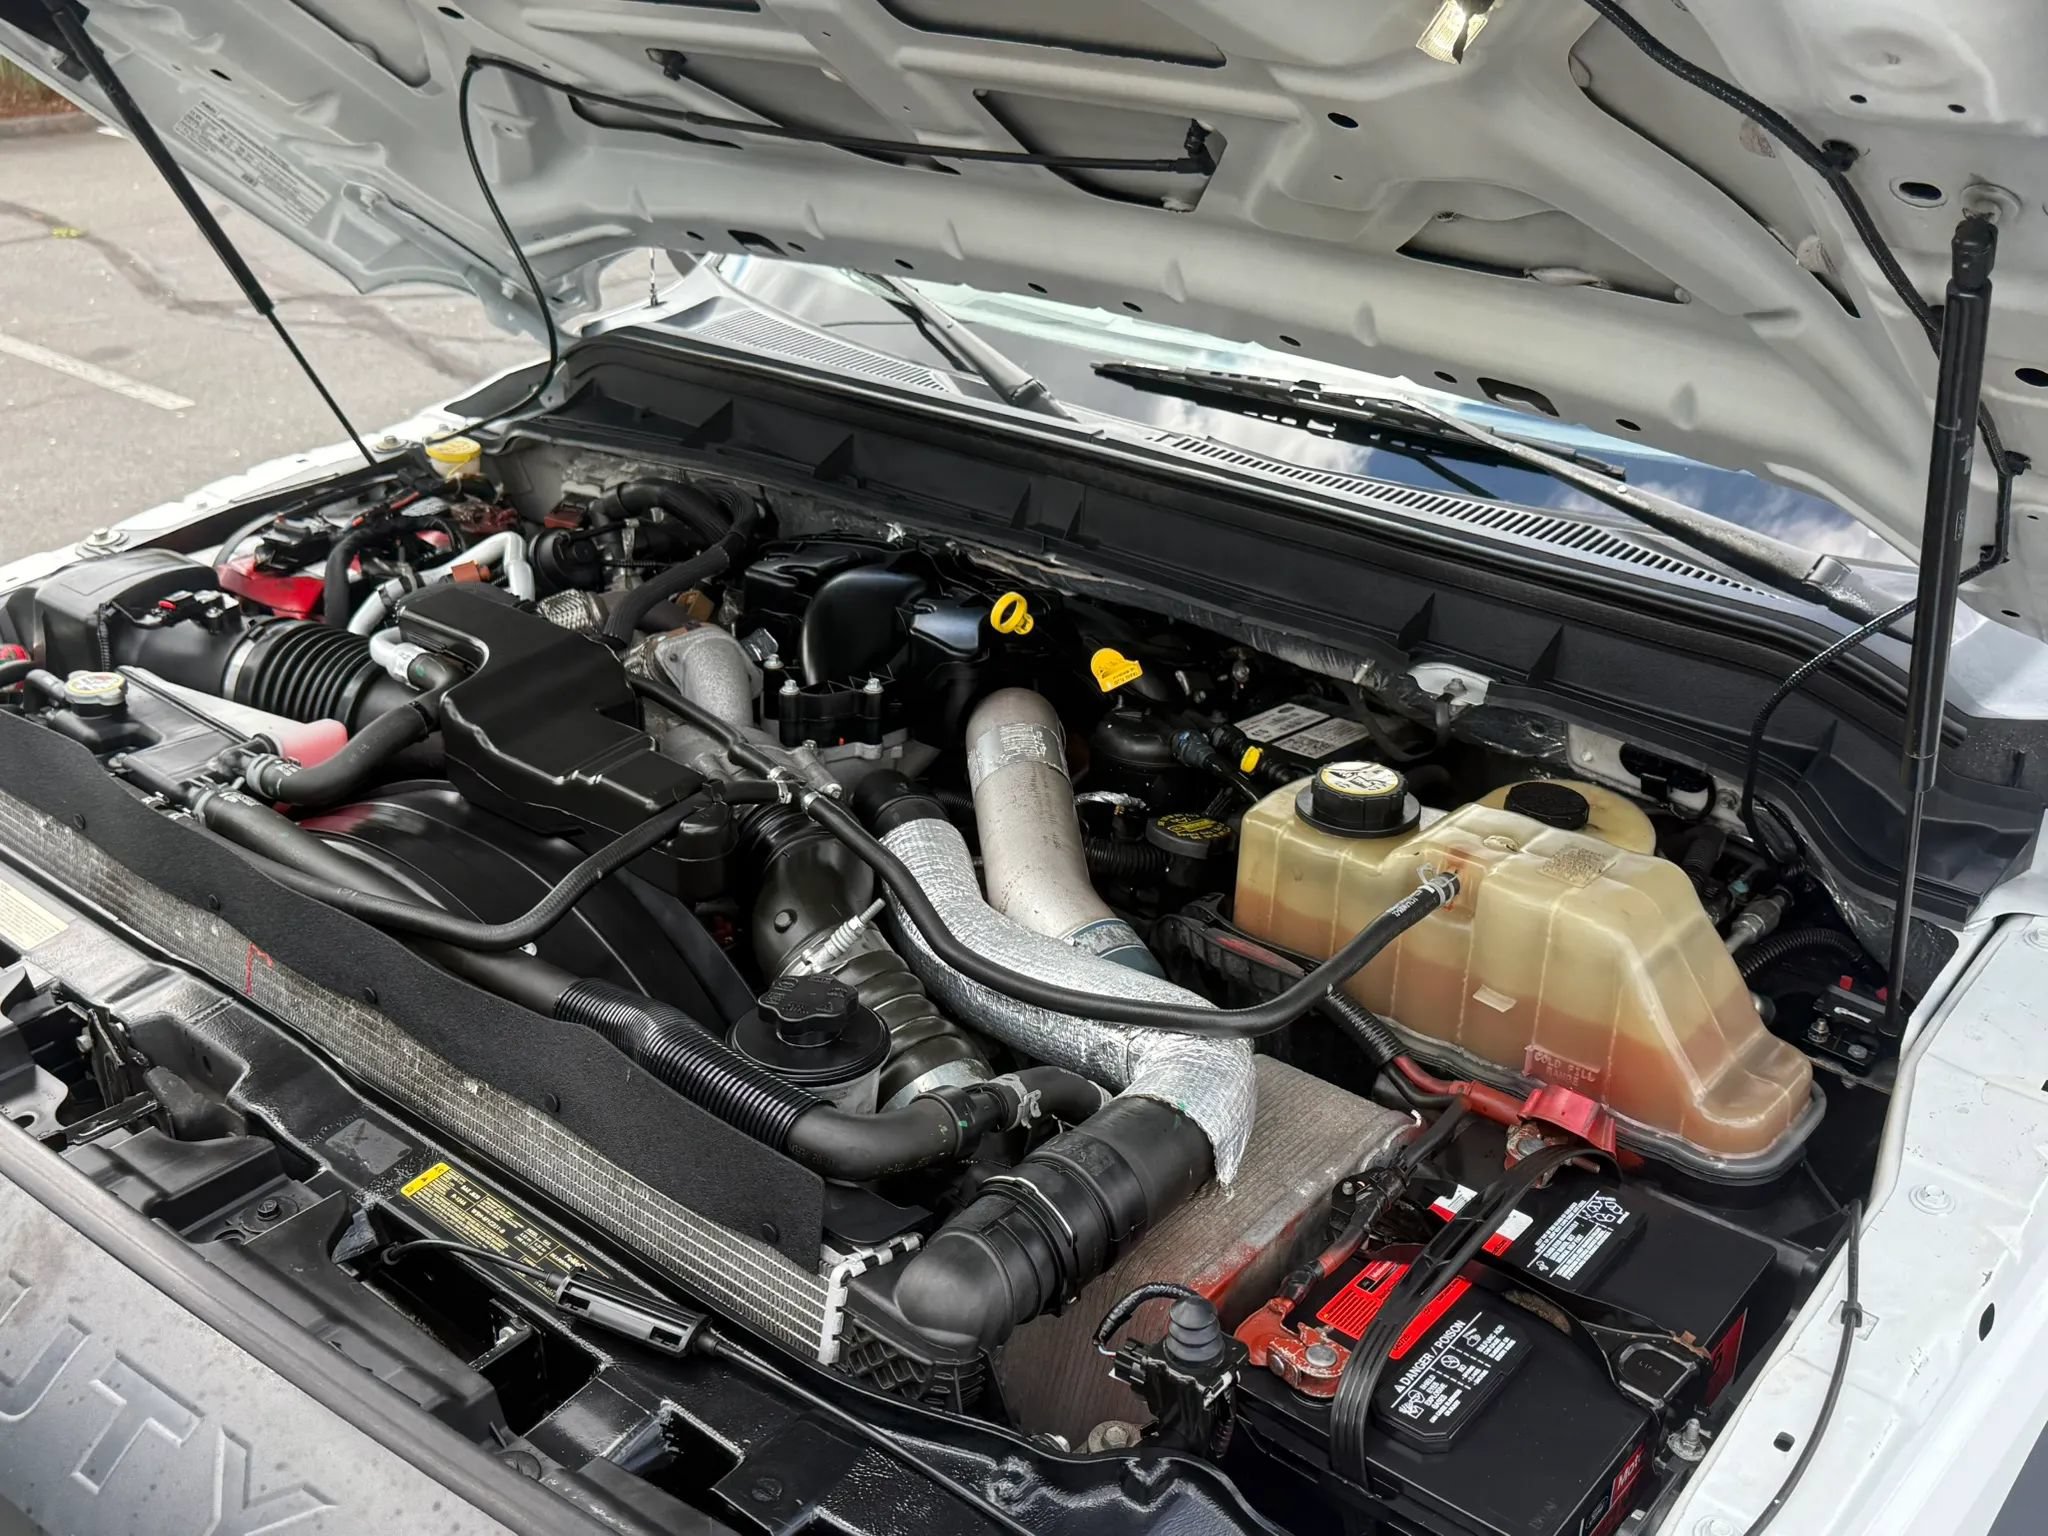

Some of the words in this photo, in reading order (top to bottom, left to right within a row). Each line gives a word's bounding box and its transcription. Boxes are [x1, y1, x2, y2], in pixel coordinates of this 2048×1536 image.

[1533, 1051, 1562, 1068] COLD
[1567, 1063, 1596, 1082] FILL
[1399, 1352, 1435, 1387] DANGER
[1434, 1319, 1467, 1350] POISON
